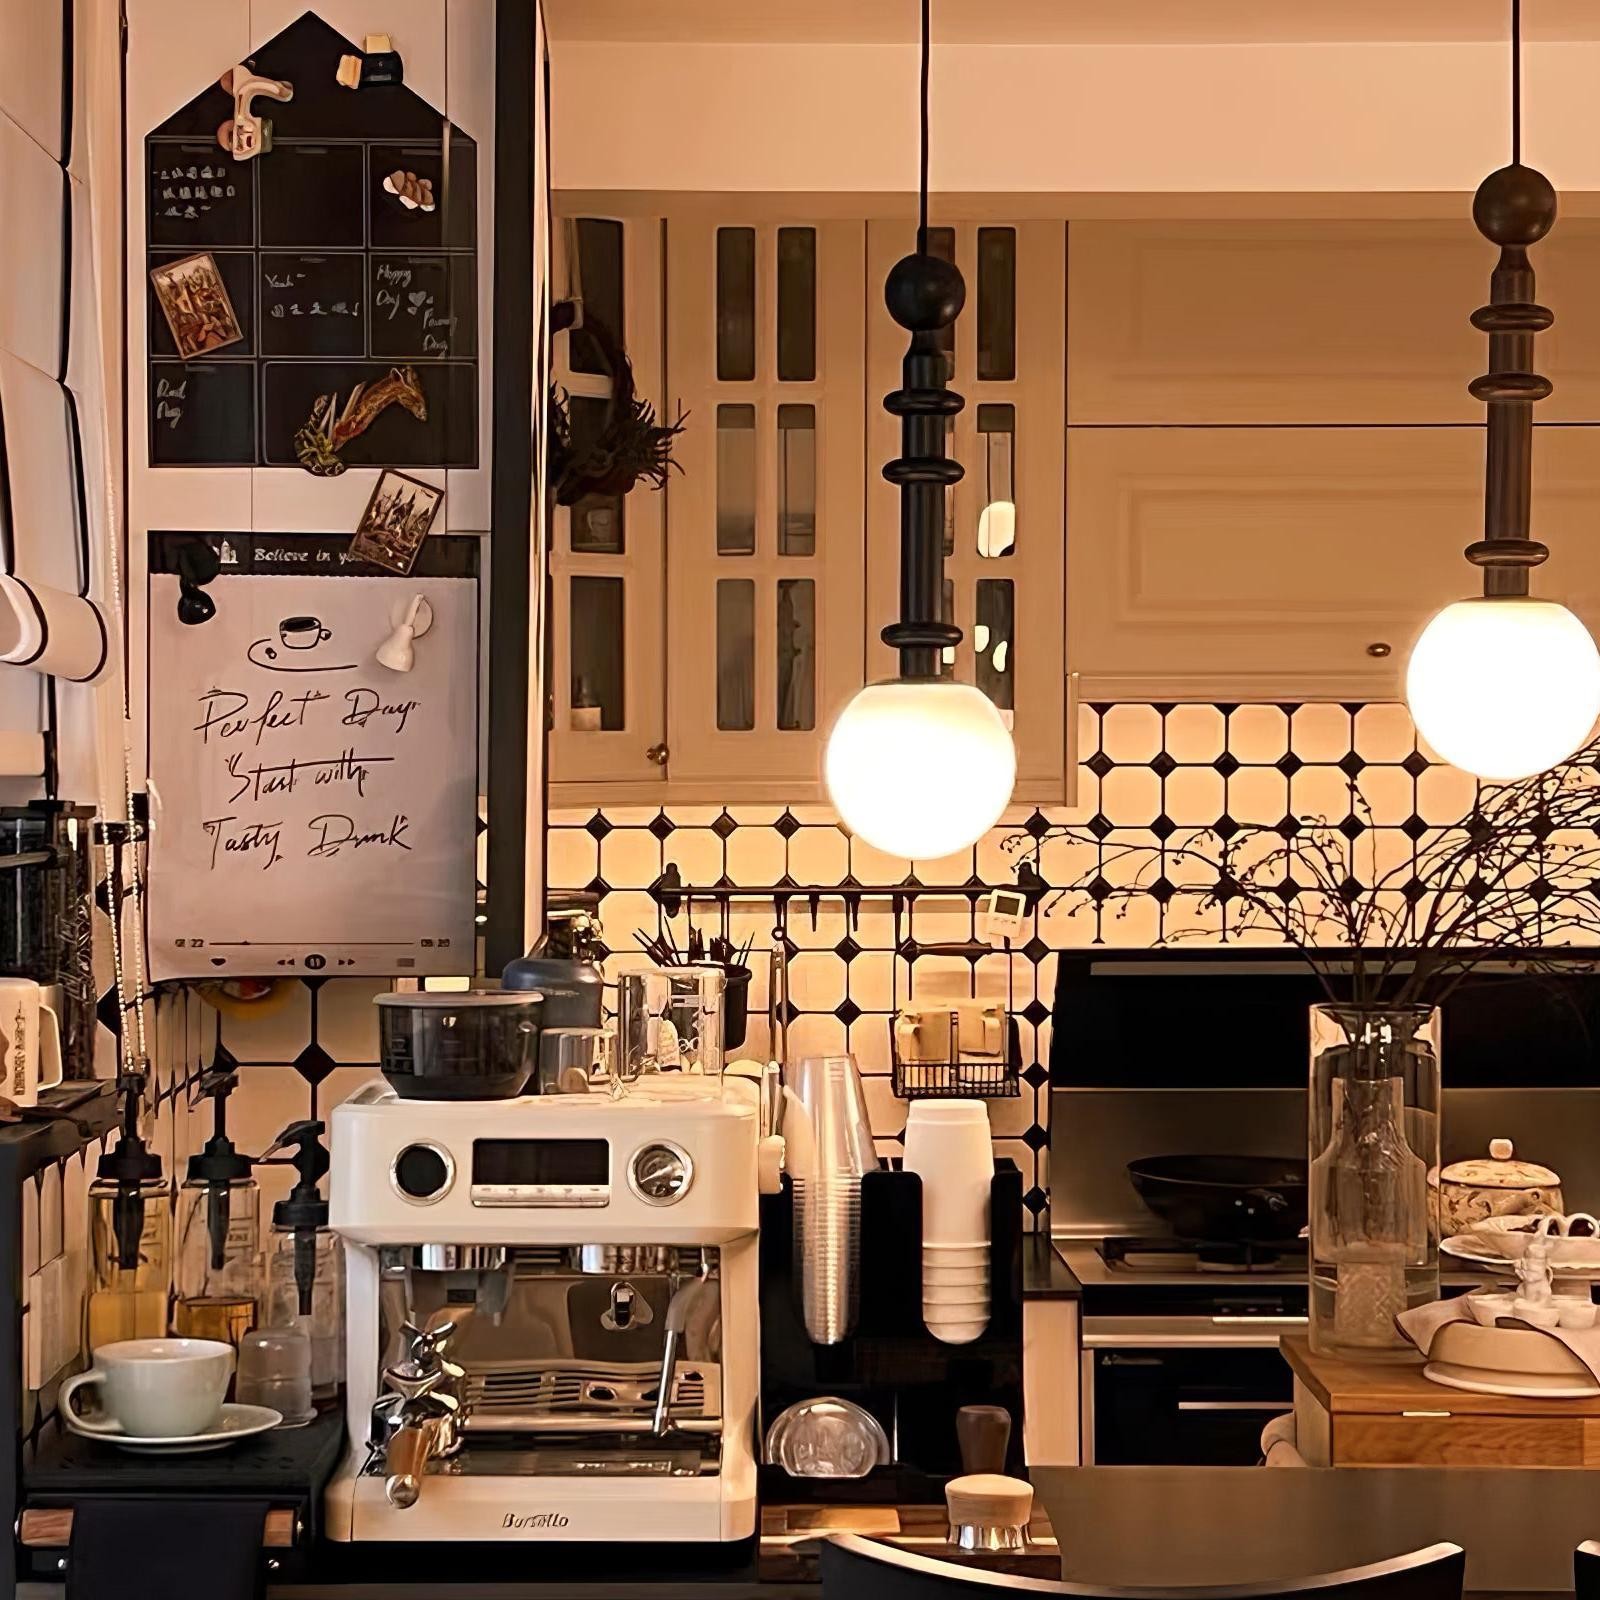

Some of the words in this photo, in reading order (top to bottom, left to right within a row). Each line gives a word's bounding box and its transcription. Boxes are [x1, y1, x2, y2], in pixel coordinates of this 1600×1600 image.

[253, 548, 308, 562] Believe
[316, 549, 331, 562] in
[193, 686, 330, 745] Perfect
[342, 688, 418, 734] Day
[225, 751, 303, 803] Start
[315, 747, 380, 797] with
[203, 816, 283, 870] Tasty
